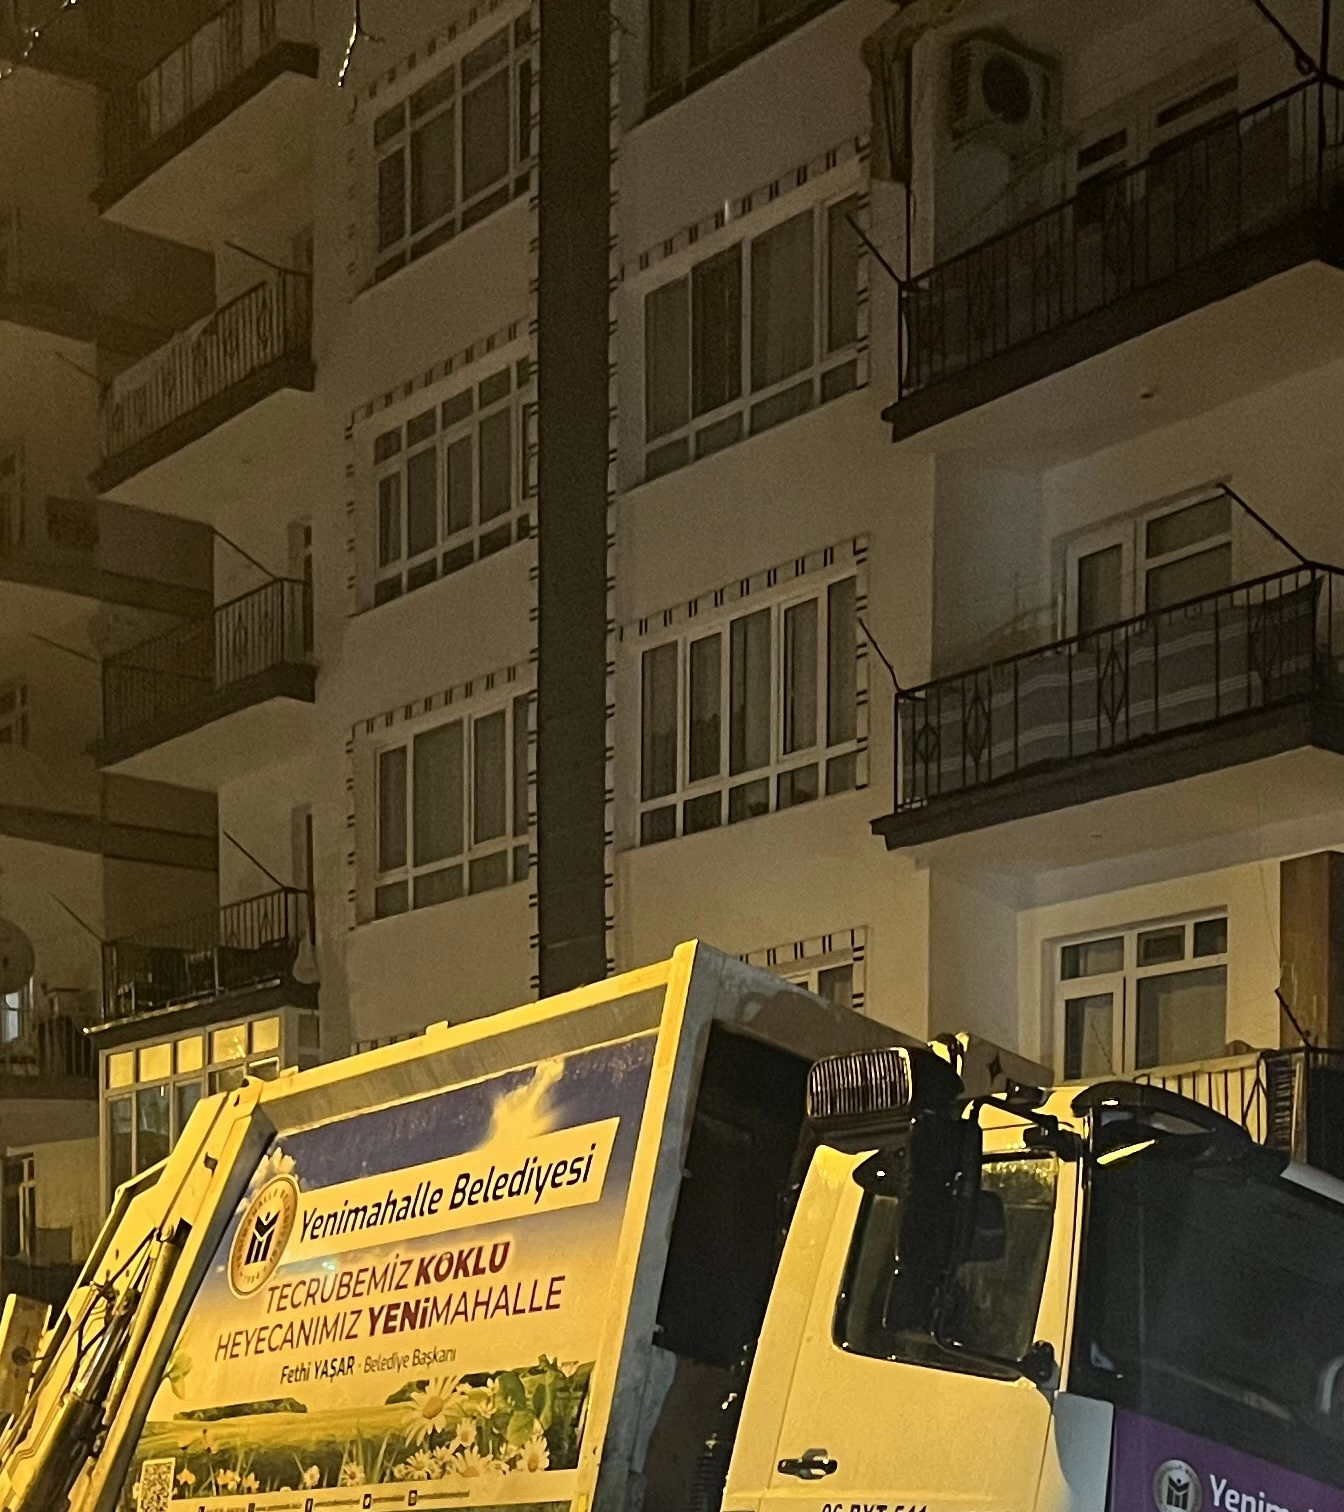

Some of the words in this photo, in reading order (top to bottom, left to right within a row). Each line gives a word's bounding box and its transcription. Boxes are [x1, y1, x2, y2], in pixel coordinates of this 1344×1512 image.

[300, 1180, 441, 1243] Yenimahalle
[449, 1142, 597, 1211] Belediyesi
[215, 1310, 363, 1361] HEYECANIMIZ
[279, 1362, 312, 1385] Fethi
[313, 1355, 356, 1383] YAŞAR
[363, 1352, 410, 1374] Belediye
